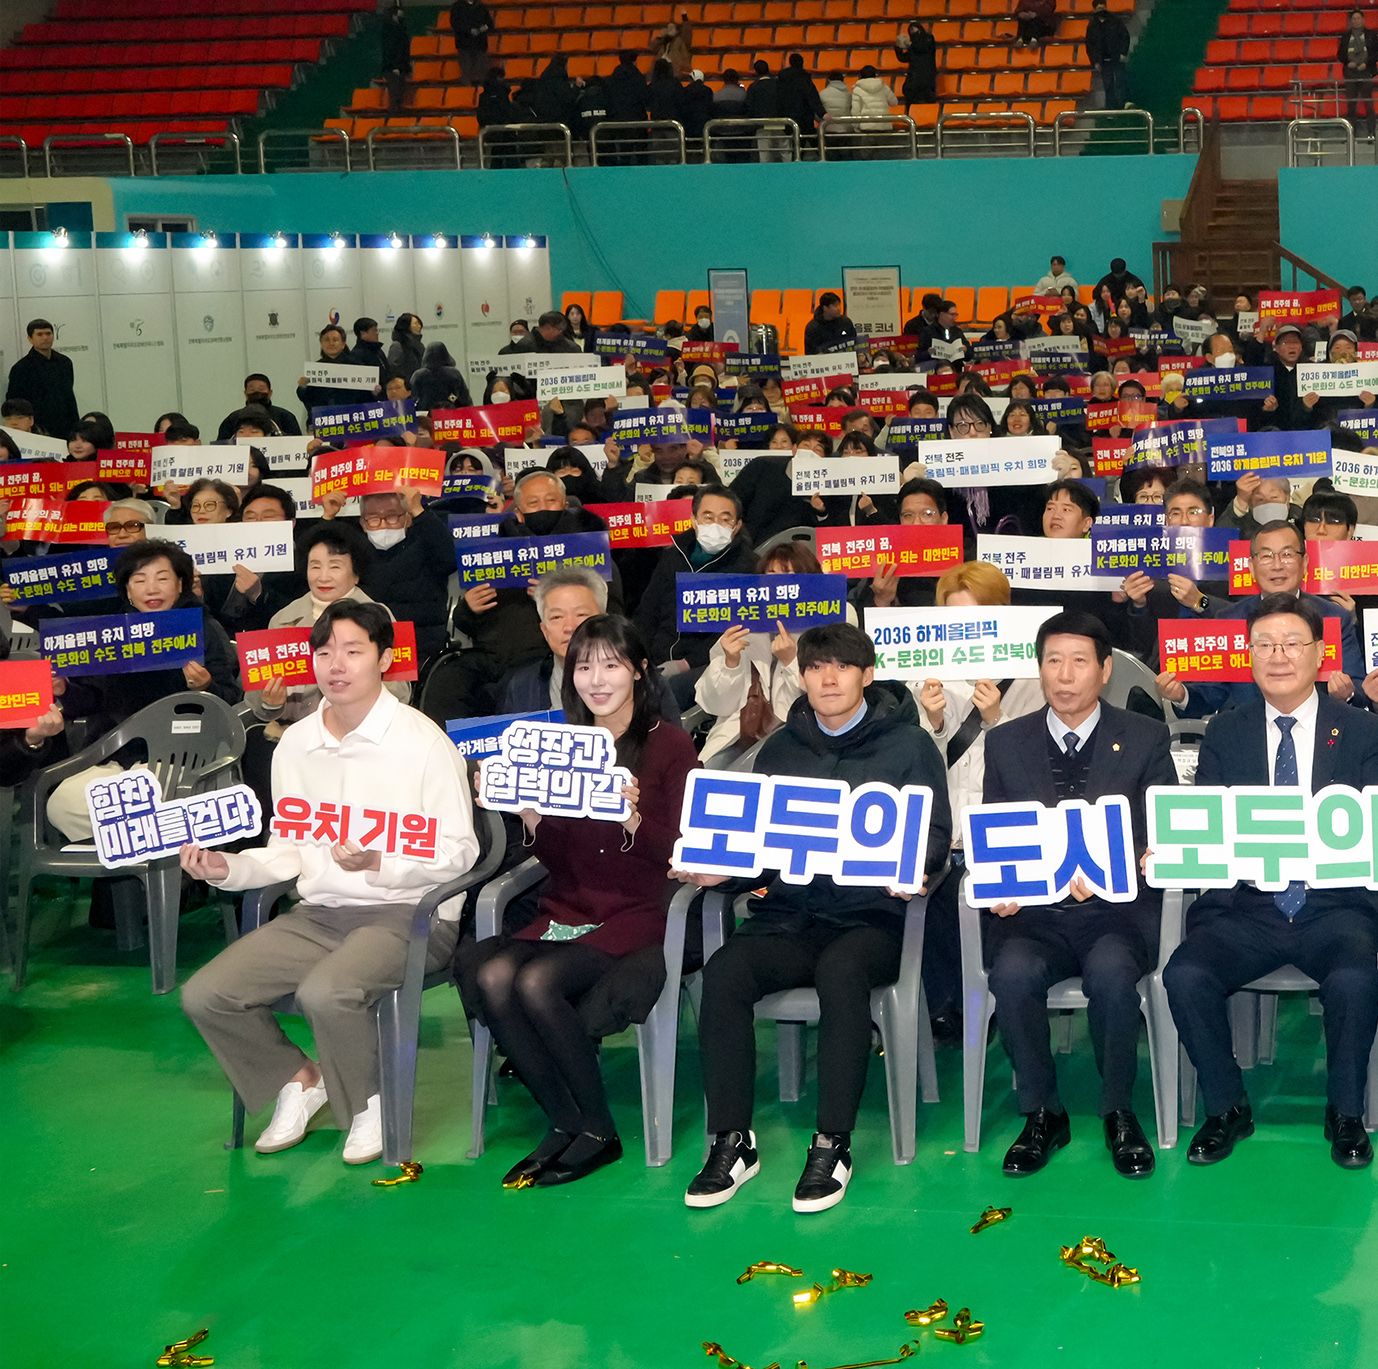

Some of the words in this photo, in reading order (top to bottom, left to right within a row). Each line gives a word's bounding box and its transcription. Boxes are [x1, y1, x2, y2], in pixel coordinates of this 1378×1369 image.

[541, 377, 558, 386] 2036
[560, 373, 596, 385] 하계올림픽
[924, 452, 943, 463] 전북
[946, 451, 964, 462] 전주
[1211, 445, 1234, 458] 전북의
[1211, 461, 1231, 472] 2036
[1234, 456, 1280, 470] 하계올림픽
[1283, 453, 1303, 466] 유치
[1306, 451, 1327, 463] 기원
[1004, 460, 1024, 472] 유치
[1027, 457, 1047, 469] 희망
[1336, 462, 1360, 473] 2036
[313, 477, 348, 497] 올림픽으로
[353, 472, 369, 486] 하나
[375, 469, 393, 482] 되는
[399, 468, 440, 480] 대한민국
[234, 547, 257, 561] 유치
[264, 543, 287, 558] 기원
[462, 549, 513, 567] 하계올림픽
[518, 546, 539, 561] 유치
[544, 542, 565, 557] 희망
[822, 542, 842, 556] 전북
[846, 538, 875, 553] 전주의
[1097, 537, 1146, 551] 하계올림픽
[1150, 535, 1169, 550] 유치
[1175, 534, 1196, 550] 희망
[822, 553, 872, 571] 올림픽으로
[877, 551, 896, 565] 하나
[900, 550, 919, 564] 되는
[923, 547, 958, 562] 대한민국
[1096, 552, 1139, 569] K-문화의
[1144, 551, 1162, 566] 수도
[1166, 551, 1186, 565] 전북
[9, 566, 58, 585] 하계올림픽
[62, 561, 83, 576] 유치
[88, 558, 108, 573] 희망
[463, 564, 506, 583] K-문화의
[510, 560, 531, 577] 수도
[1314, 566, 1333, 581] 되는
[682, 587, 741, 605] 하계올림픽
[746, 587, 769, 602] 유치
[776, 583, 800, 600] 희망
[683, 605, 731, 624] K-문화의
[737, 604, 760, 620] 수도
[766, 601, 790, 619] 전북
[795, 598, 840, 617] 전주에서
[44, 629, 98, 650] 하계올림픽
[102, 626, 125, 643] 유치
[130, 622, 155, 639] 희망
[874, 626, 911, 645] 2036
[917, 620, 998, 642] 하계올림픽
[1165, 636, 1188, 653] 전북
[1194, 633, 1228, 651] 전주의
[95, 646, 117, 663] 수도
[123, 641, 145, 659] 전북
[151, 632, 197, 654] 전주에서
[245, 646, 270, 665] 전북
[276, 641, 310, 661] 전주의
[875, 644, 944, 669] K-문화의
[951, 643, 985, 664] 수도
[248, 659, 307, 682] 올림픽으로
[1165, 654, 1223, 673] 올림픽으로
[508, 727, 609, 769] 성장과
[92, 776, 155, 820] 힘찬
[485, 764, 583, 808] 협력의
[584, 771, 623, 812] 길
[98, 809, 188, 861] 미래를
[188, 792, 254, 840] 걷다
[274, 803, 348, 845] 유치
[358, 809, 436, 858] 기원
[681, 778, 924, 884] 모두의
[970, 802, 1126, 900] 도시
